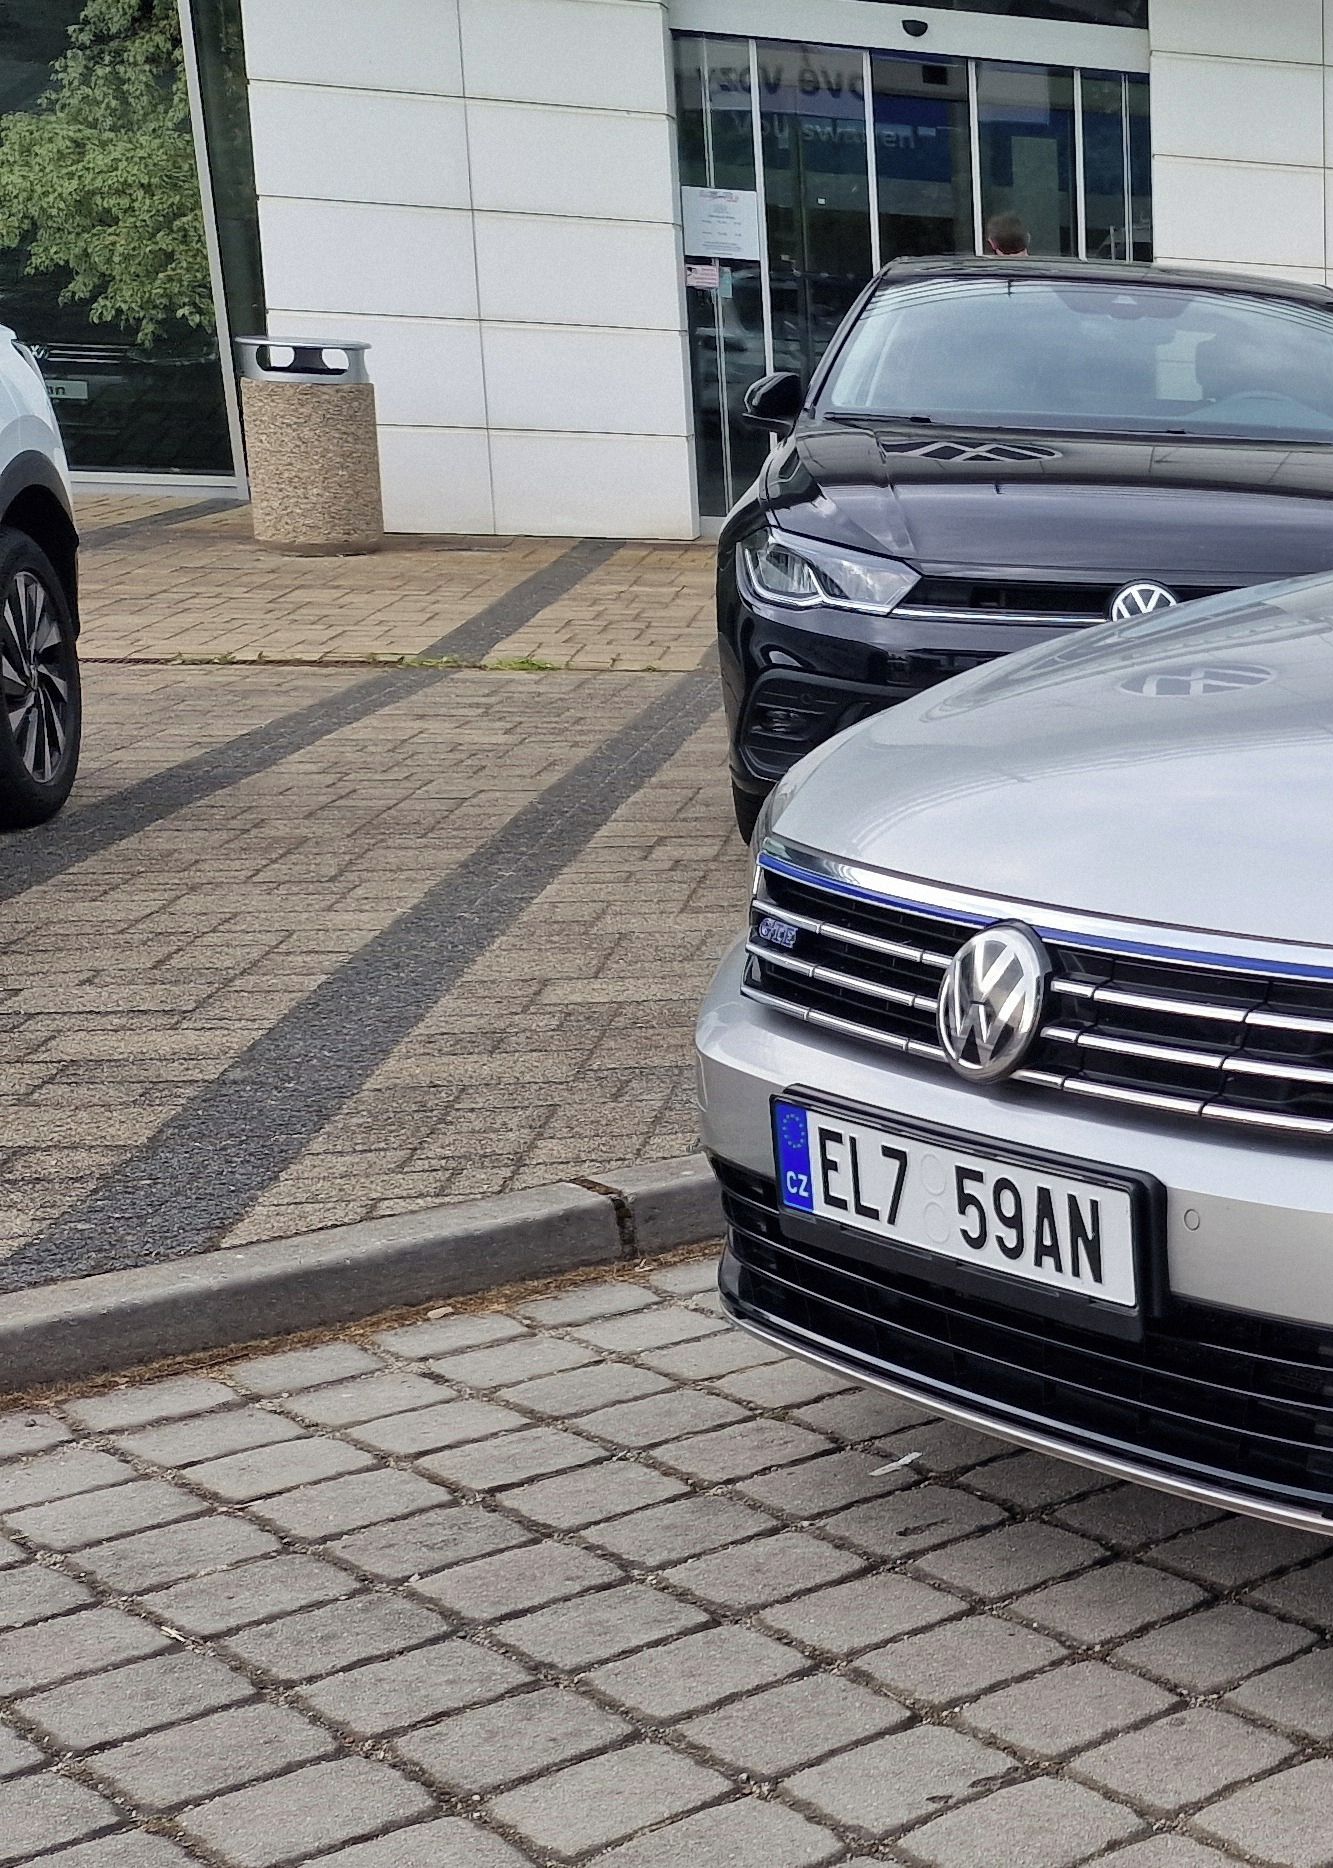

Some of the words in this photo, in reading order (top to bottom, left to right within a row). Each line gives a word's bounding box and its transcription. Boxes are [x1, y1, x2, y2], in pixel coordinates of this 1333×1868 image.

[759, 918, 798, 948] GTE
[939, 928, 1041, 1078] VW
[786, 1170, 809, 1197] CZ
[818, 1126, 907, 1226] EL7
[954, 1164, 1103, 1285] 59AN
